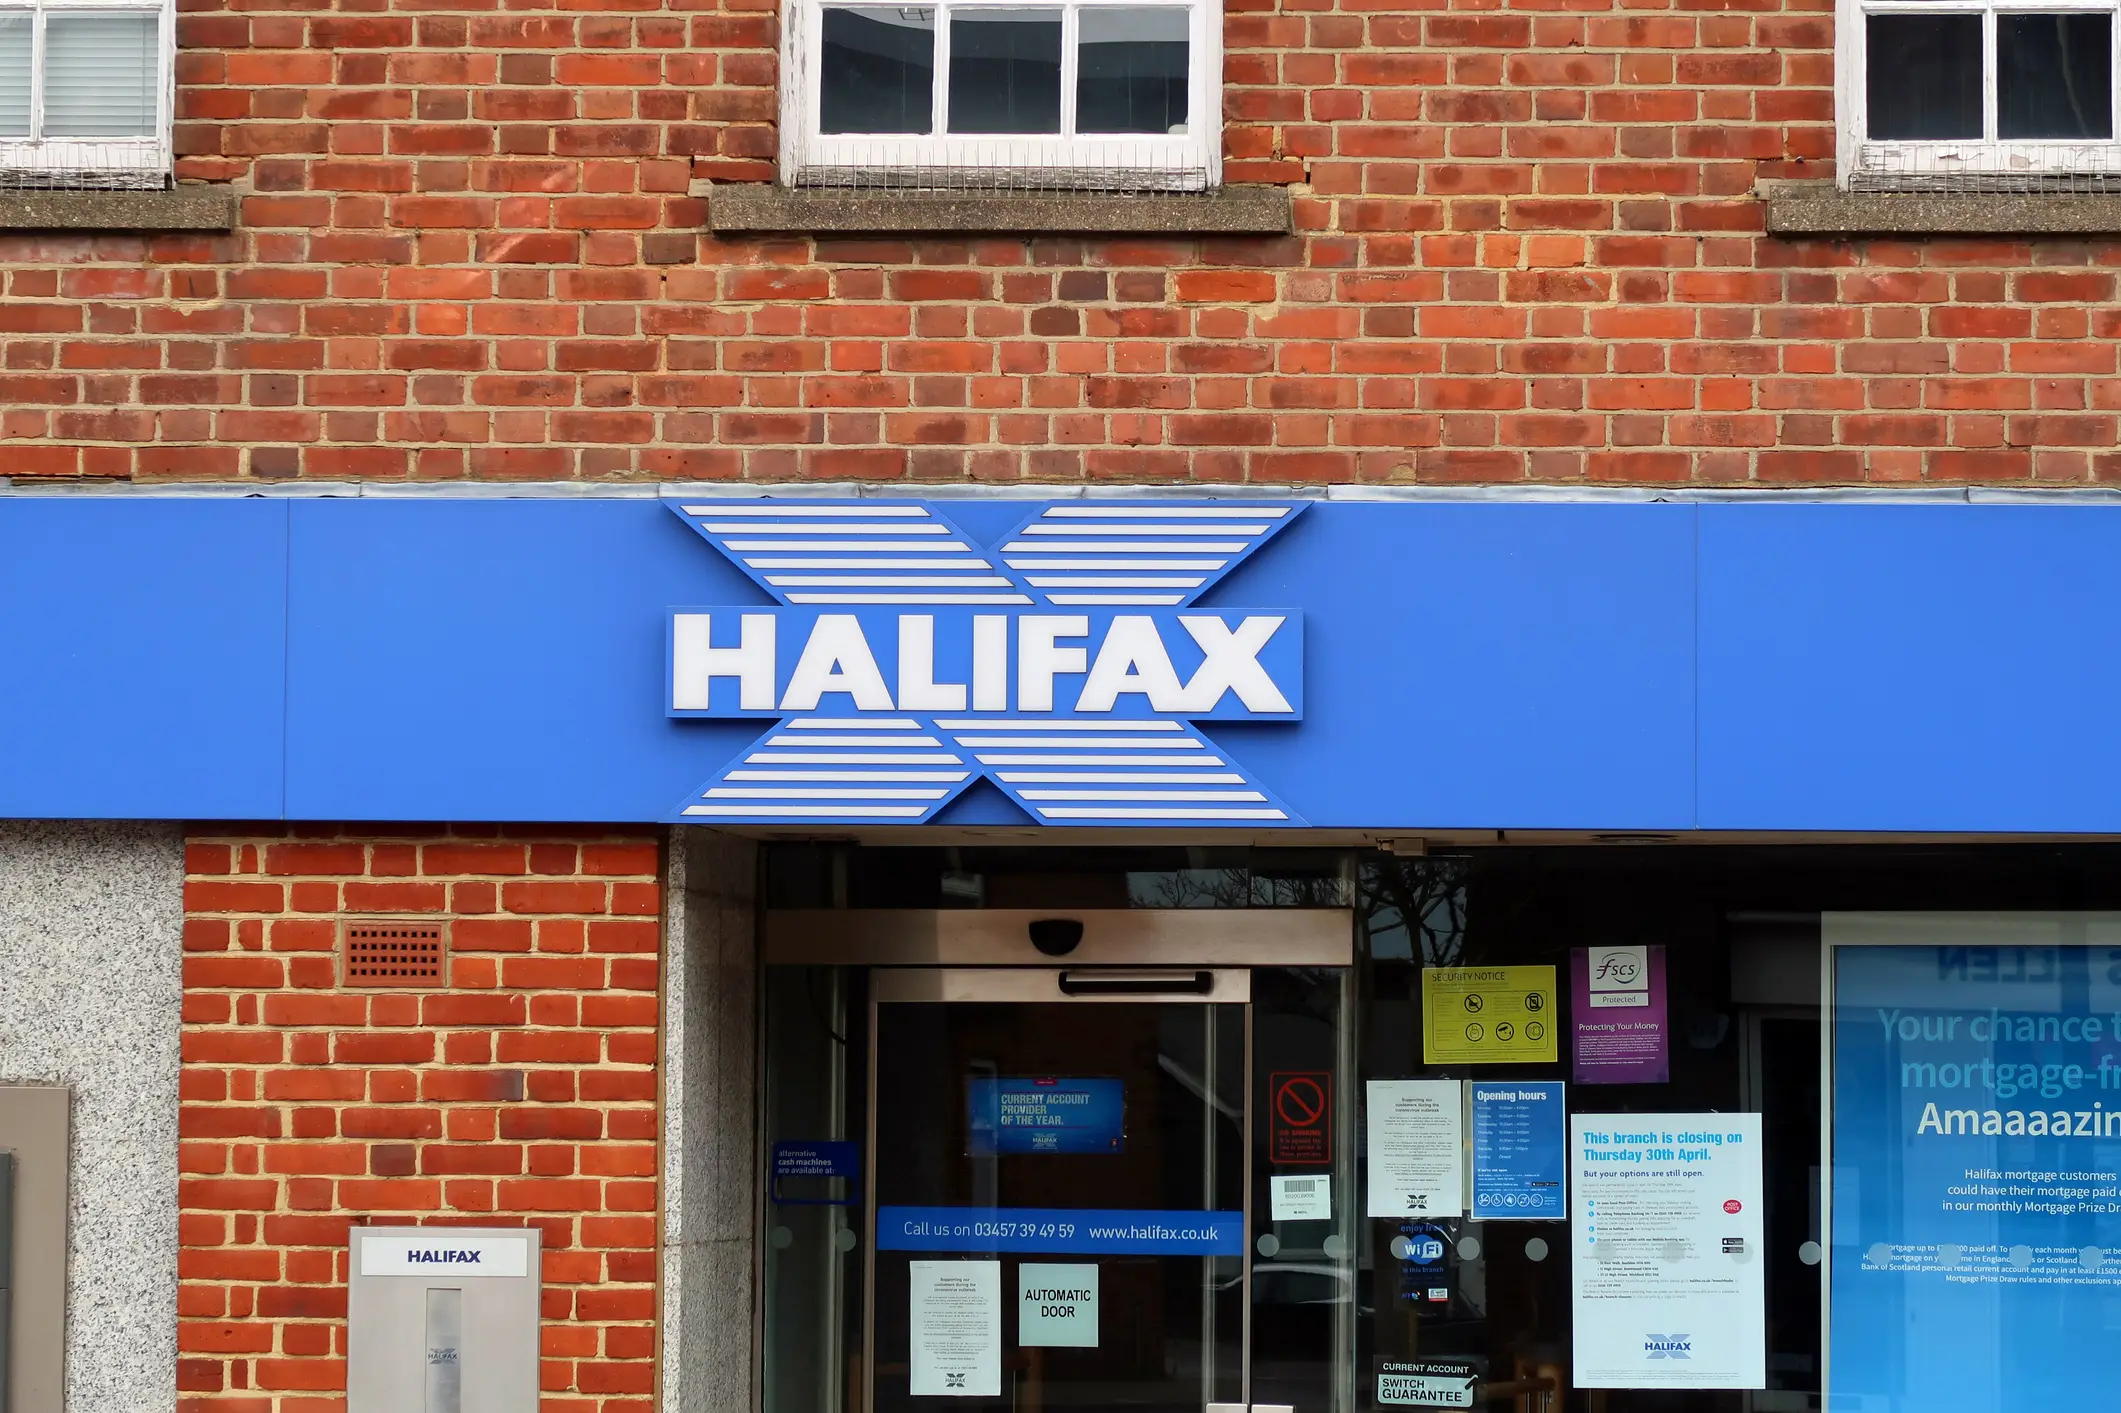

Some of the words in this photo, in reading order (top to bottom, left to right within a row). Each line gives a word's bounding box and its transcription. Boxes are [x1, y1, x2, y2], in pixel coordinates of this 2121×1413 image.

[673, 614, 1295, 713] HALIFAX
[1432, 972, 1473, 982] SECURITY
[1474, 971, 1506, 980] NOTICE
[1578, 1023, 1616, 1032] Protecting
[1616, 1022, 1634, 1030] Your
[1634, 1022, 1659, 1031] Money
[1877, 1008, 1962, 1042] Your
[1969, 1007, 2103, 1042] chance
[1001, 1095, 1044, 1105] CURRENT
[1046, 1094, 1090, 1105] ACCOUNT
[1477, 1090, 1516, 1103] Opening
[1518, 1090, 1547, 1101] hours
[1001, 1105, 1047, 1115] PROVIDER
[1001, 1115, 1013, 1125] OF
[1017, 1115, 1033, 1125] THE
[1035, 1115, 1064, 1126] YEAR.
[1583, 1132, 1610, 1144] This
[1614, 1132, 1658, 1144] branch
[1662, 1132, 1673, 1144] is
[1677, 1132, 1723, 1146] closing
[1727, 1133, 1743, 1143] on
[778, 1158, 794, 1166] cash
[795, 1158, 832, 1166] machines
[1583, 1149, 1642, 1163] Thursday
[1646, 1149, 1674, 1161] 30th
[1678, 1149, 1712, 1163] April.
[1583, 1170, 1598, 1178] But
[1599, 1171, 1618, 1180] your
[1619, 1170, 1650, 1180] options
[1666, 1169, 1681, 1177] still
[1683, 1171, 1705, 1179] open.
[1965, 1168, 2002, 1180] Halifax
[2005, 1170, 2057, 1183] mortgage
[2059, 1171, 2117, 1181] customers
[1948, 1184, 1978, 1195] could
[1980, 1184, 2007, 1196] have
[2009, 1185, 2036, 1196] their
[2037, 1187, 2090, 1199] mortgage
[2092, 1186, 2116, 1199] paid
[1942, 1200, 1953, 1211] in
[1955, 1202, 1974, 1211] our
[1976, 1201, 2022, 1214] monthly
[2024, 1202, 2076, 1215] Mortgage
[2078, 1202, 2106, 1213] Prize
[904, 1221, 930, 1236] Call
[933, 1225, 950, 1236] us
[954, 1225, 970, 1237] on
[974, 1223, 1016, 1237] 03457
[1019, 1223, 1037, 1238] 39
[1039, 1223, 1056, 1238] 49
[1058, 1224, 1075, 1238] 59
[1089, 1224, 1219, 1241] www.halifax.co.uk
[1400, 1225, 1424, 1234] enjoy
[1916, 1245, 1927, 1254] up
[1969, 1245, 1985, 1253] paid
[1986, 1244, 1998, 1252] off.
[408, 1250, 481, 1263] HALIFAX
[2046, 1256, 2078, 1264] Scotland
[1861, 1263, 1880, 1271] Bank
[1889, 1263, 1921, 1272] Scotland
[1921, 1264, 1953, 1273] personal
[1954, 1264, 1972, 1272] retail
[1973, 1266, 1999, 1274] current
[2030, 1266, 2044, 1274] and
[2060, 1266, 2068, 1274] in
[2078, 1267, 2095, 1275] least
[1945, 1275, 1979, 1284] Mortgage
[1980, 1274, 1997, 1282] Prize
[1999, 1275, 2018, 1283] Draw
[2019, 1275, 2037, 1283] rules
[2038, 1276, 2053, 1284] and
[2053, 1276, 2073, 1284] other
[2074, 1276, 2111, 1285] exclusions
[1025, 1289, 1092, 1302] AUTOMATIC
[1041, 1305, 1076, 1318] DOOR
[1645, 1342, 1691, 1351] HALIFAX
[428, 1353, 458, 1361] HALIFAX
[1383, 1362, 1425, 1372] CURRENT
[1426, 1364, 1469, 1374] ACCOUNT
[1382, 1378, 1425, 1388] SWITCH
[1382, 1388, 1462, 1402] GUARANTEE
